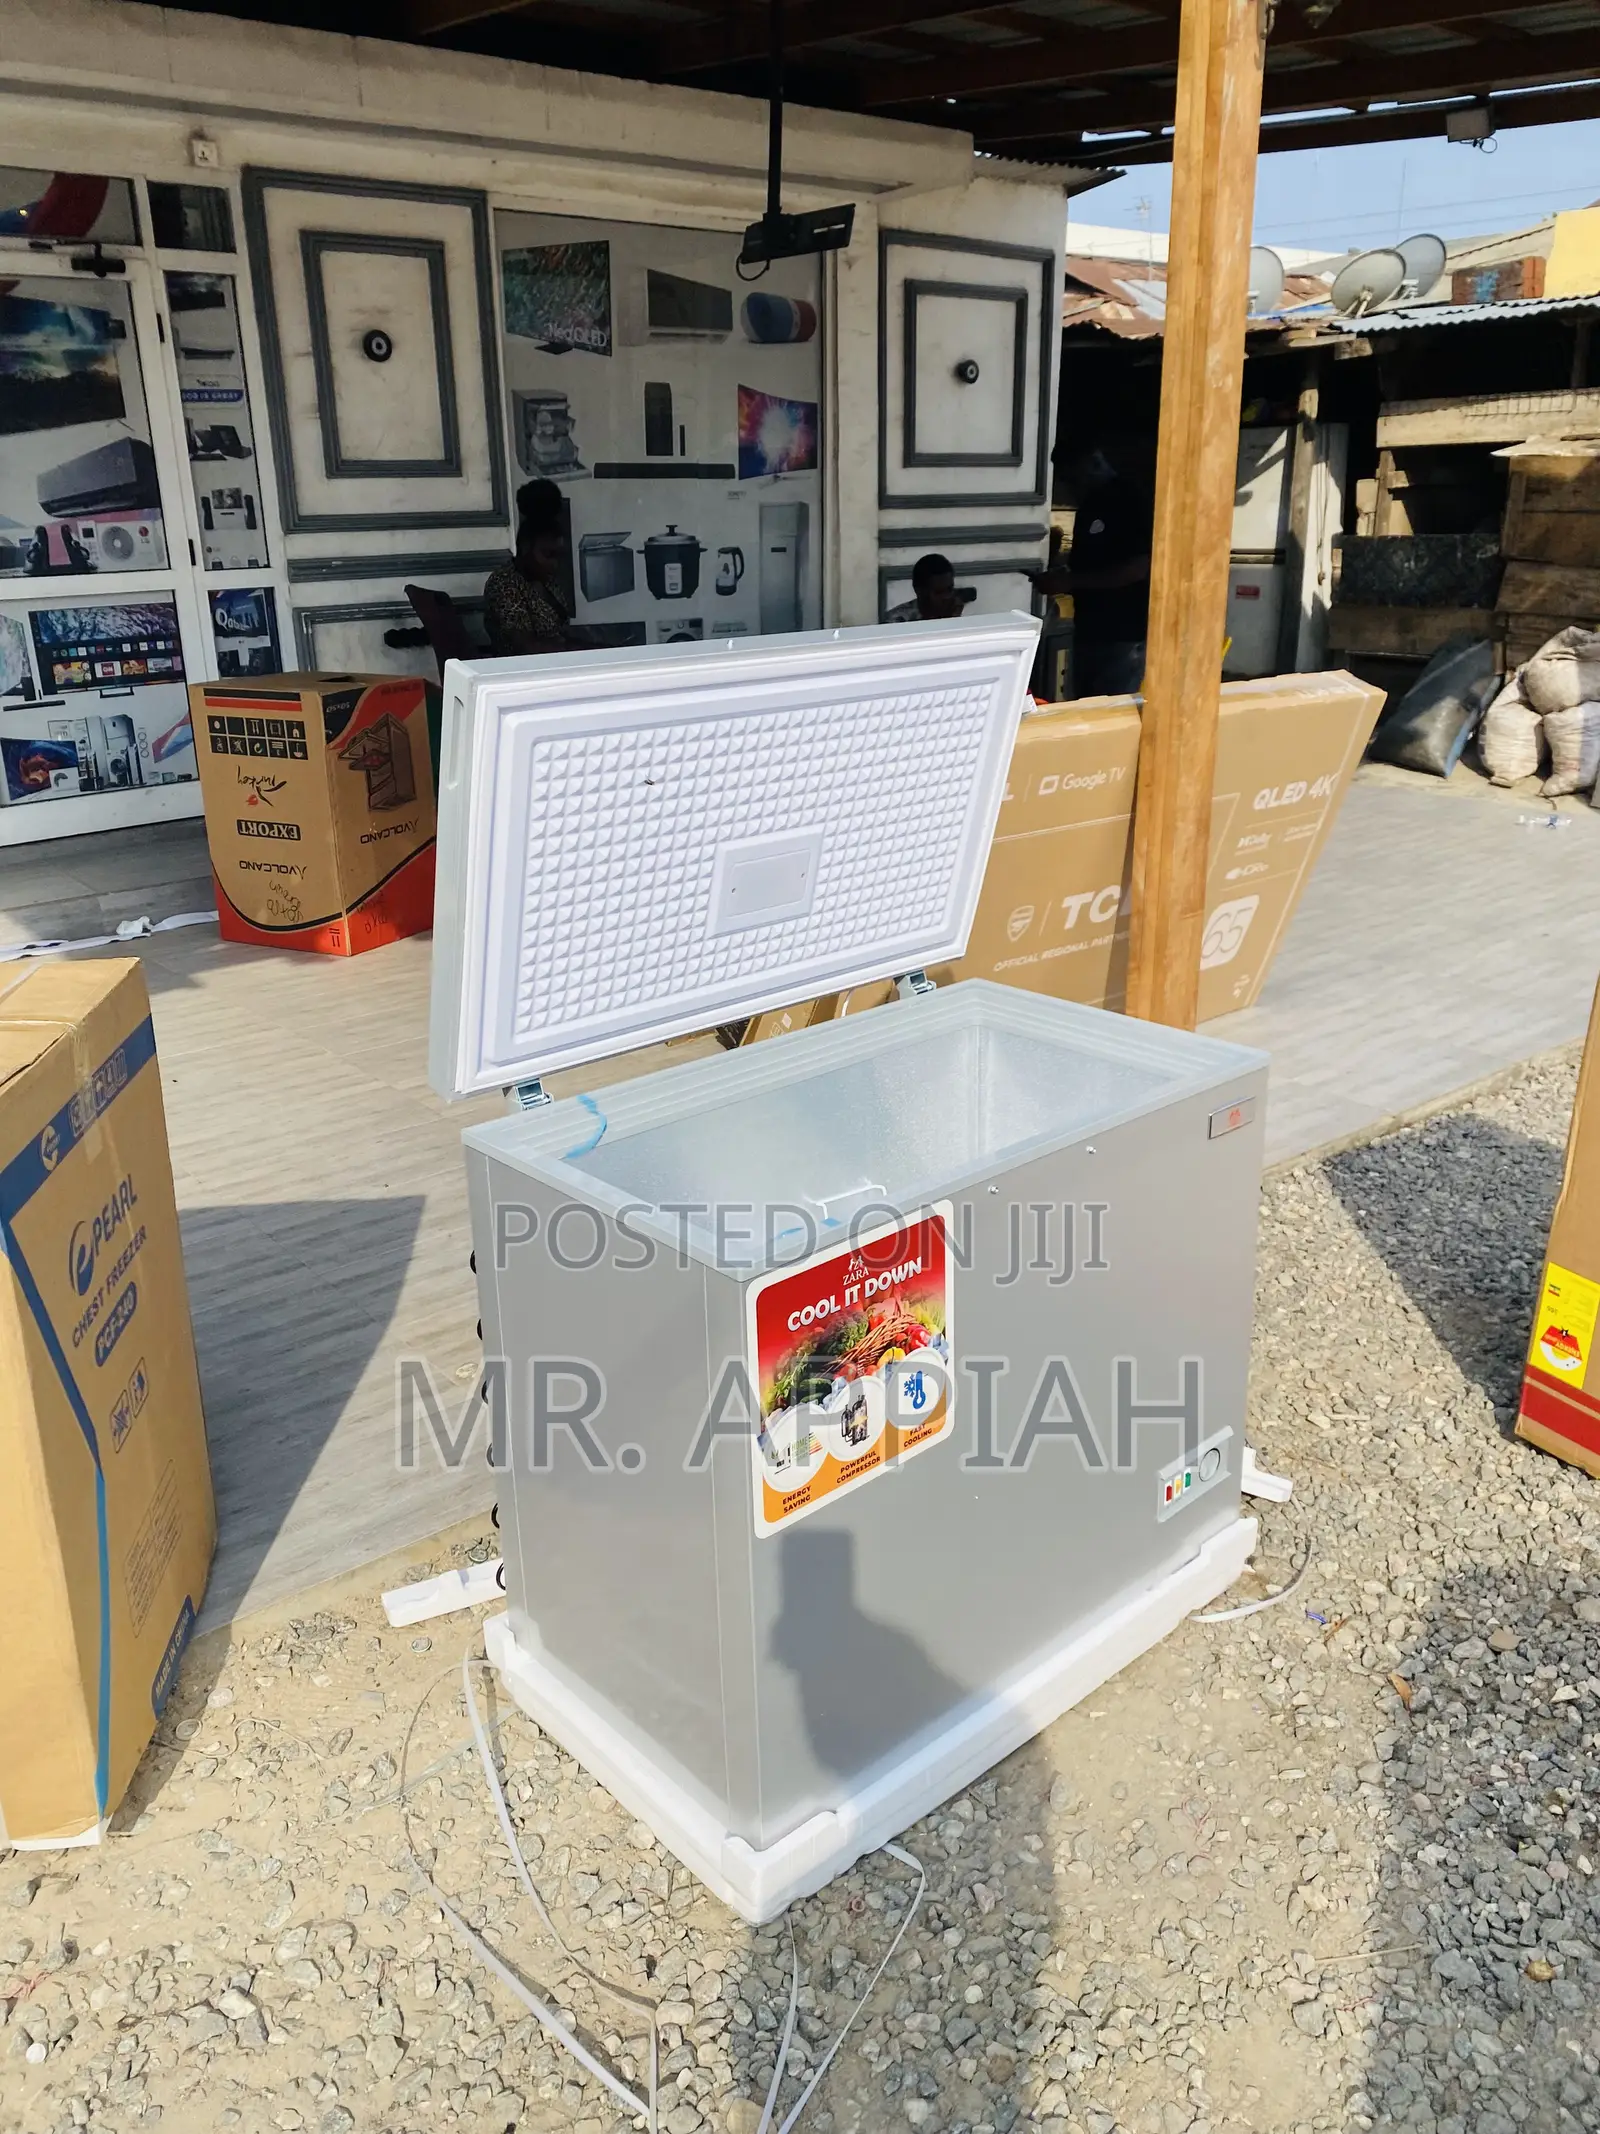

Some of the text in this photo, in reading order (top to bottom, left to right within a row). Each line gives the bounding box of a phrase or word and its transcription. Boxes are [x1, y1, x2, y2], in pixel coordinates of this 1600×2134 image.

[1062, 766, 1127, 790] Google TV
[1253, 773, 1340, 810] QLED 4K
[238, 819, 299, 840] EXPORT
[360, 823, 412, 845] VOLCANO
[239, 860, 300, 876] VOLCANO
[1201, 906, 1253, 959] 65
[993, 931, 1130, 972] OFFICIAL REGIONAL PARTNE
[92, 1173, 138, 1257] PEARL
[72, 1224, 148, 1348] CHEST FREEZER
[842, 1267, 869, 1286] ZARA
[787, 1256, 922, 1332] COOL IT DOWN
[903, 1427, 933, 1448] COOLING
[909, 1423, 927, 1436] FAST
[836, 1456, 881, 1484] COMPRESSOR
[840, 1450, 877, 1474] POWERFUL
[782, 1485, 812, 1505] ENERGY
[783, 1494, 811, 1514] SAVING
[154, 1657, 171, 1700] MADE
[174, 1608, 191, 1648] CHINA
